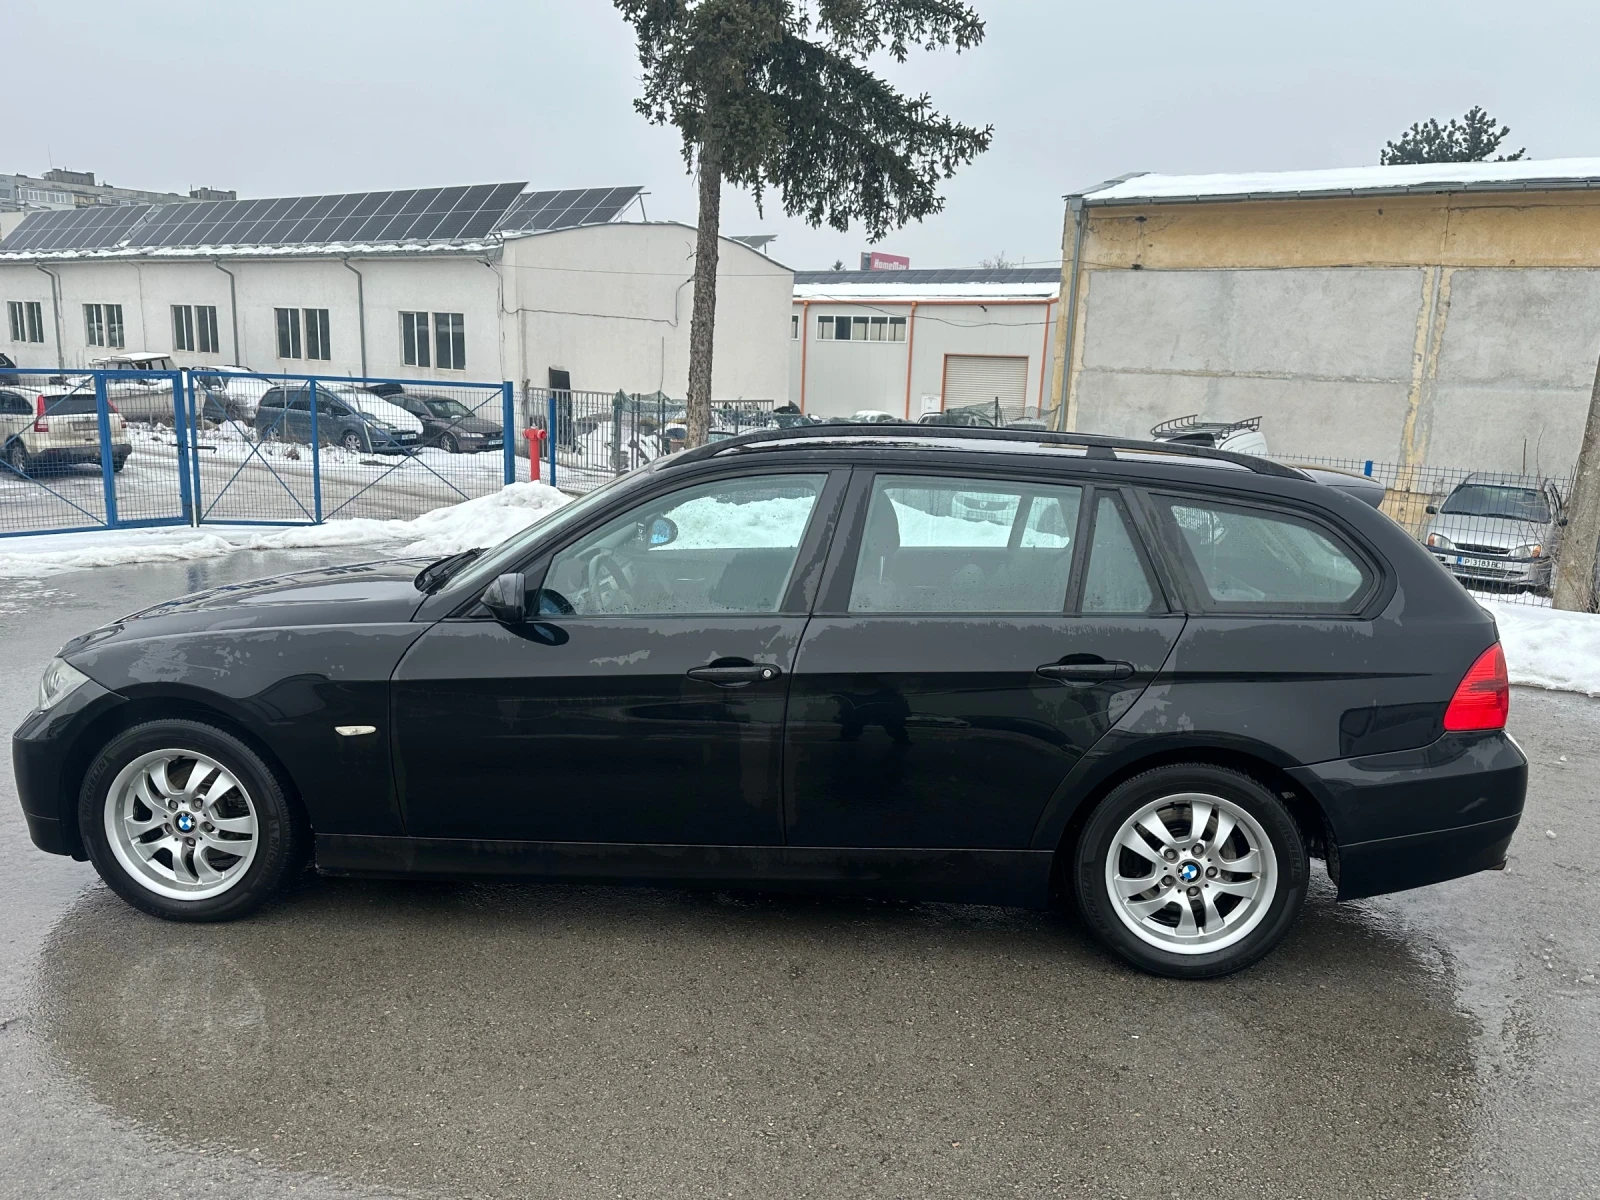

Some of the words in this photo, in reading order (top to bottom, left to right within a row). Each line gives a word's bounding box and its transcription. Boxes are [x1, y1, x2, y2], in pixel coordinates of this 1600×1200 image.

[83, 757, 109, 817] MICHELIN
[1275, 816, 1301, 880] MICHELIN
[1082, 865, 1106, 929] MICHELIN
